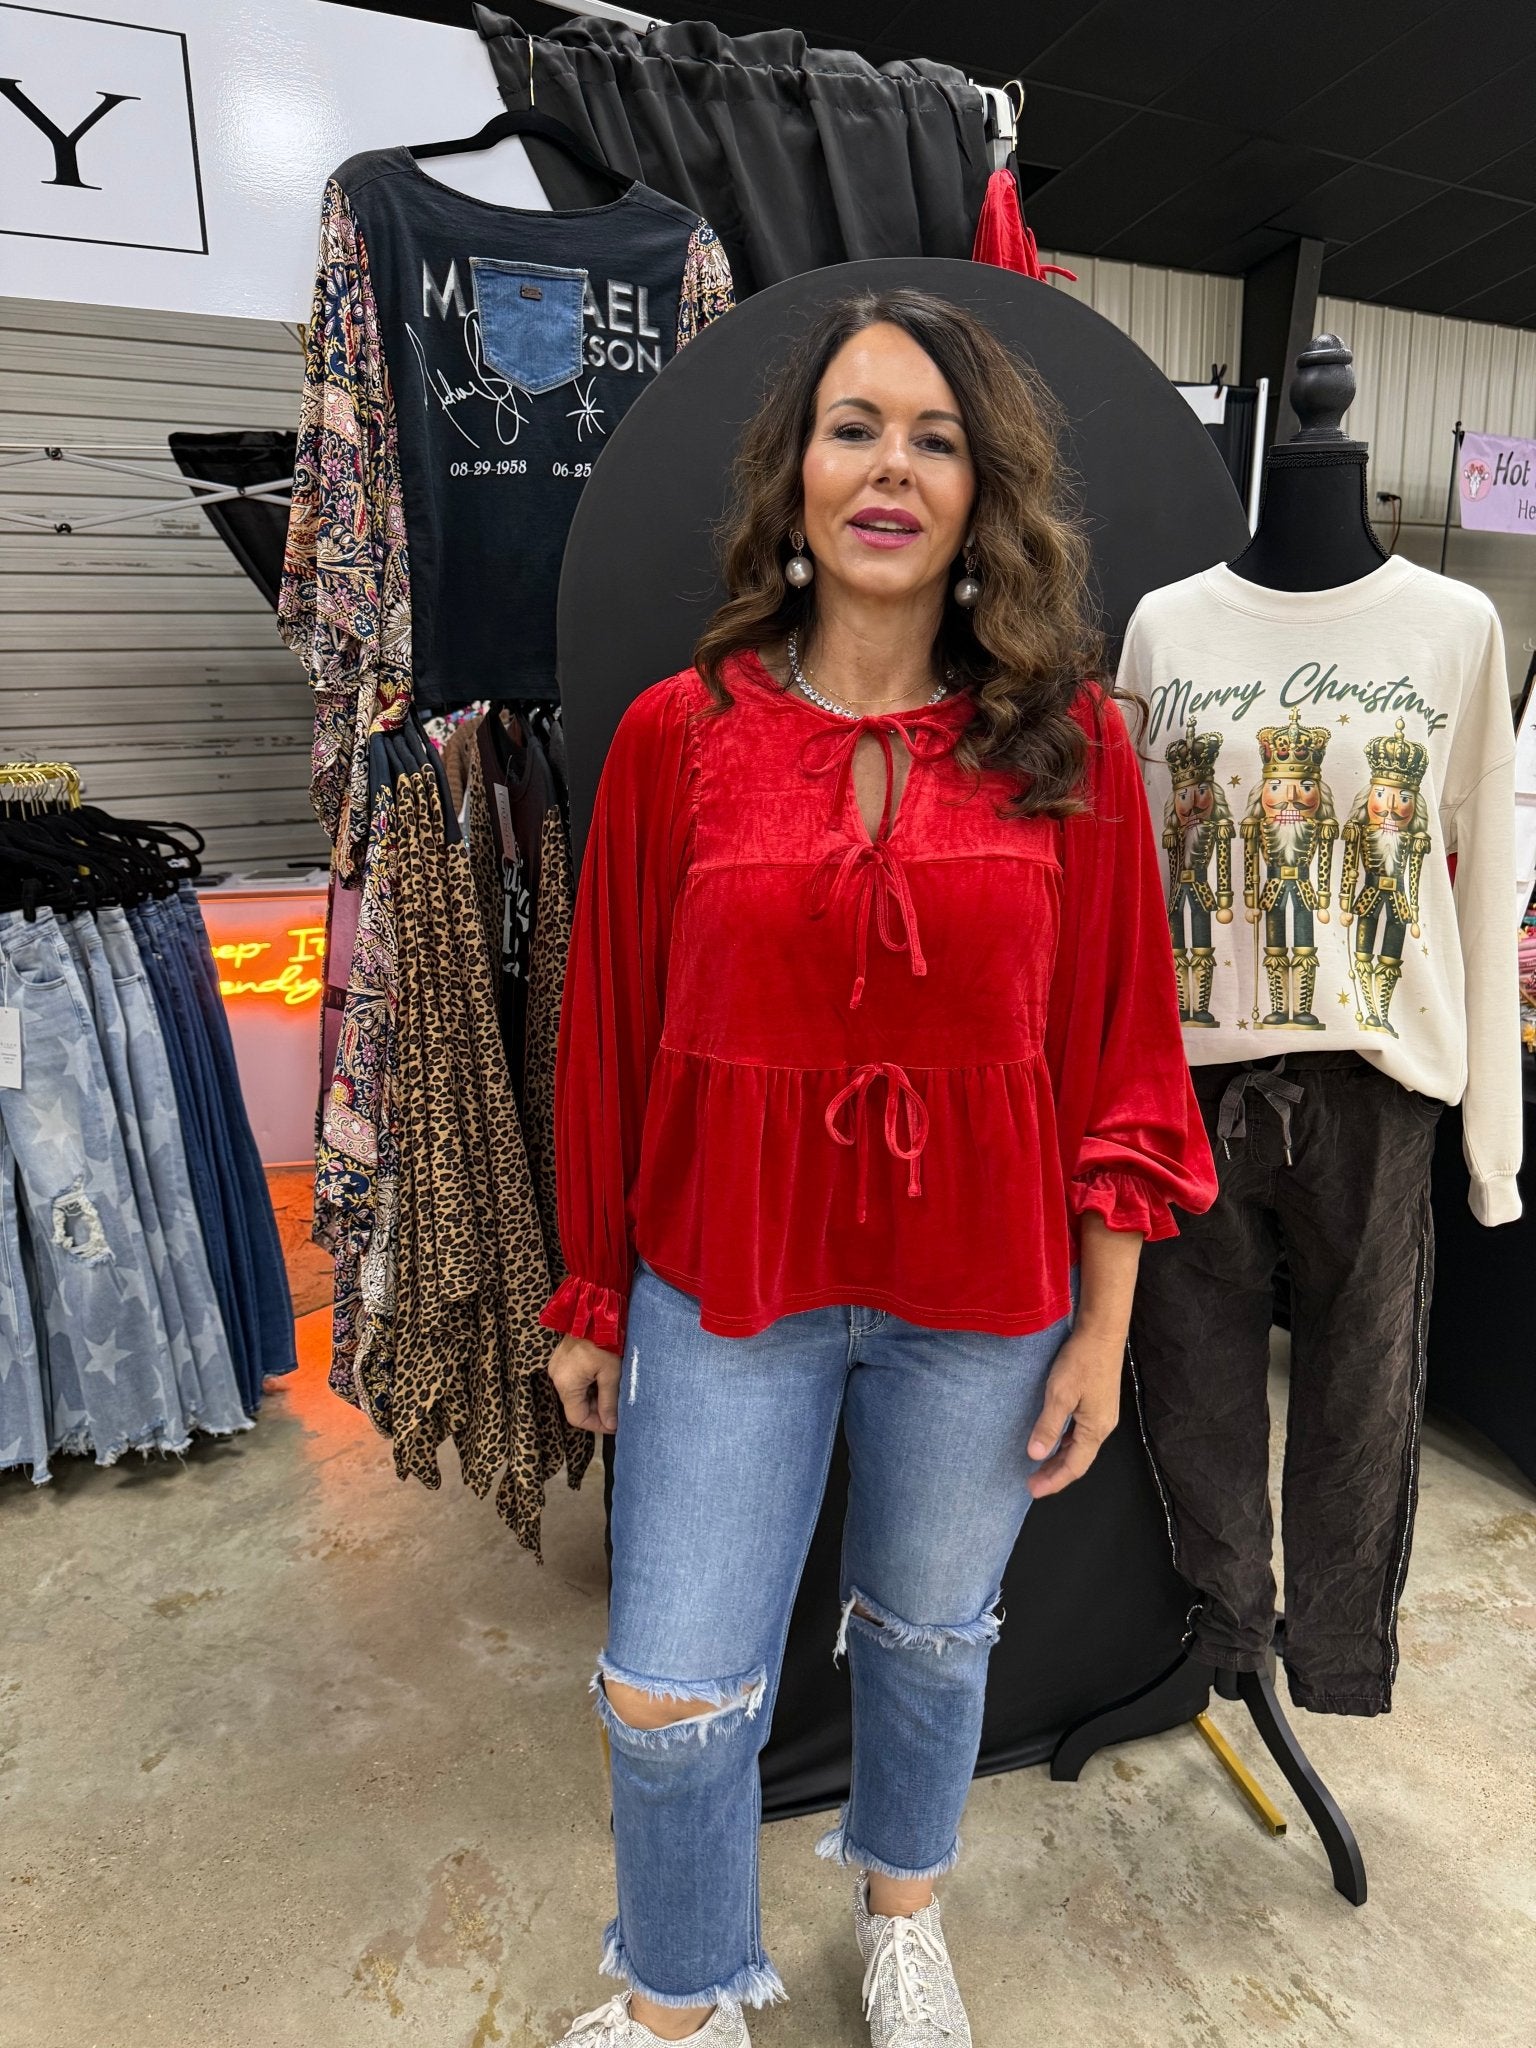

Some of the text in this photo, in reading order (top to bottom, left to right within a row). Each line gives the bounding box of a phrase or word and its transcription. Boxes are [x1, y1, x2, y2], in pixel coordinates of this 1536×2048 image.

[0, 77, 141, 190] Y
[422, 257, 660, 338] MAEL
[450, 459, 592, 479] 08-29-1958 06-25
[1492, 451, 1531, 486] Hot
[1518, 498, 1536, 520] He
[1150, 678, 1266, 745] Merry
[211, 942, 272, 969] ep
[219, 964, 322, 1005] endy
